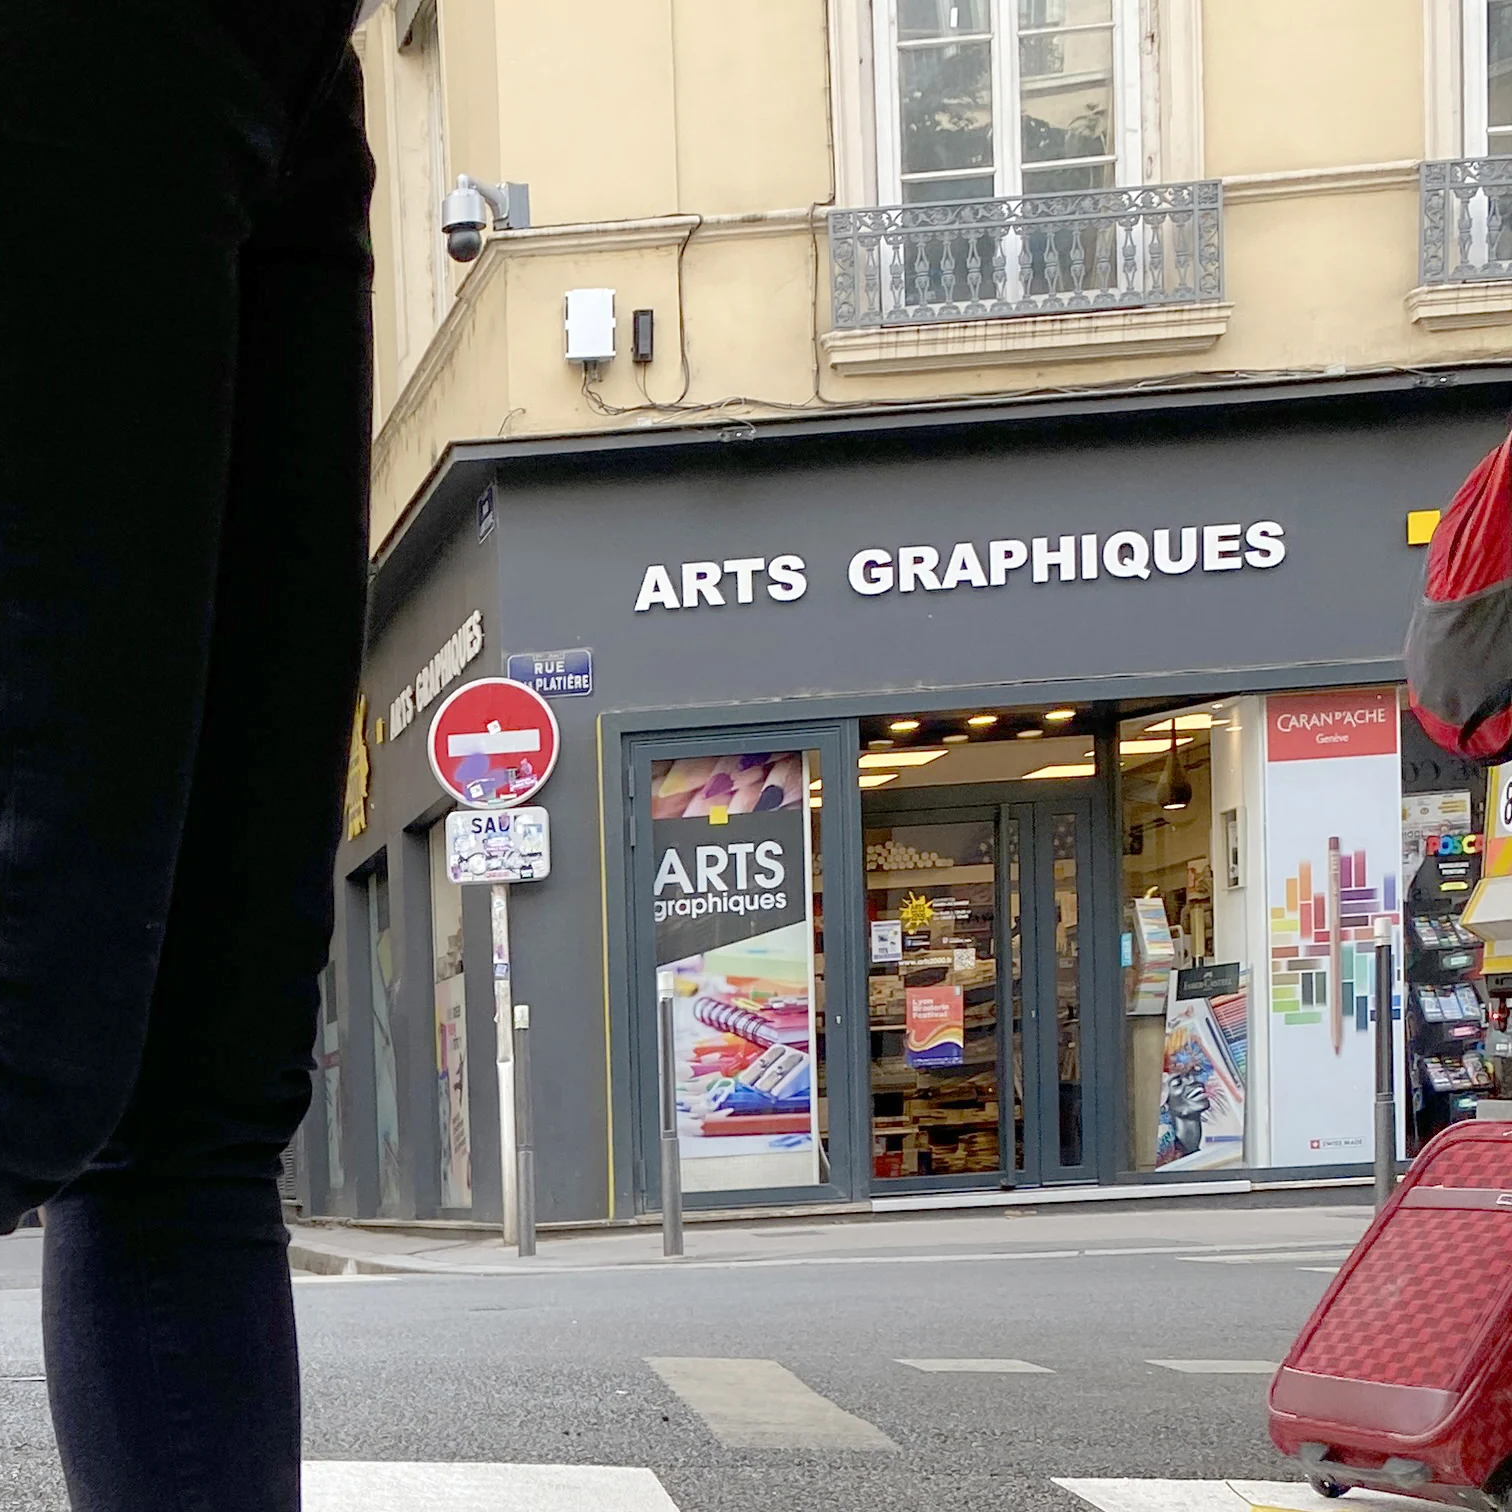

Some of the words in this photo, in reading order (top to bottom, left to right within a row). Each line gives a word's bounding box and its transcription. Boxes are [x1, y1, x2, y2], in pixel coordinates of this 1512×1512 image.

[634, 554, 808, 611] ARTS
[847, 520, 1286, 595] GRAPHIQUES
[390, 684, 414, 741] ARTS
[416, 609, 485, 713] GRAPHIQUES
[534, 661, 565, 675] RUE
[1316, 733, 1349, 744] Genève
[654, 840, 785, 896] ARTS
[654, 892, 787, 922] graphiques
